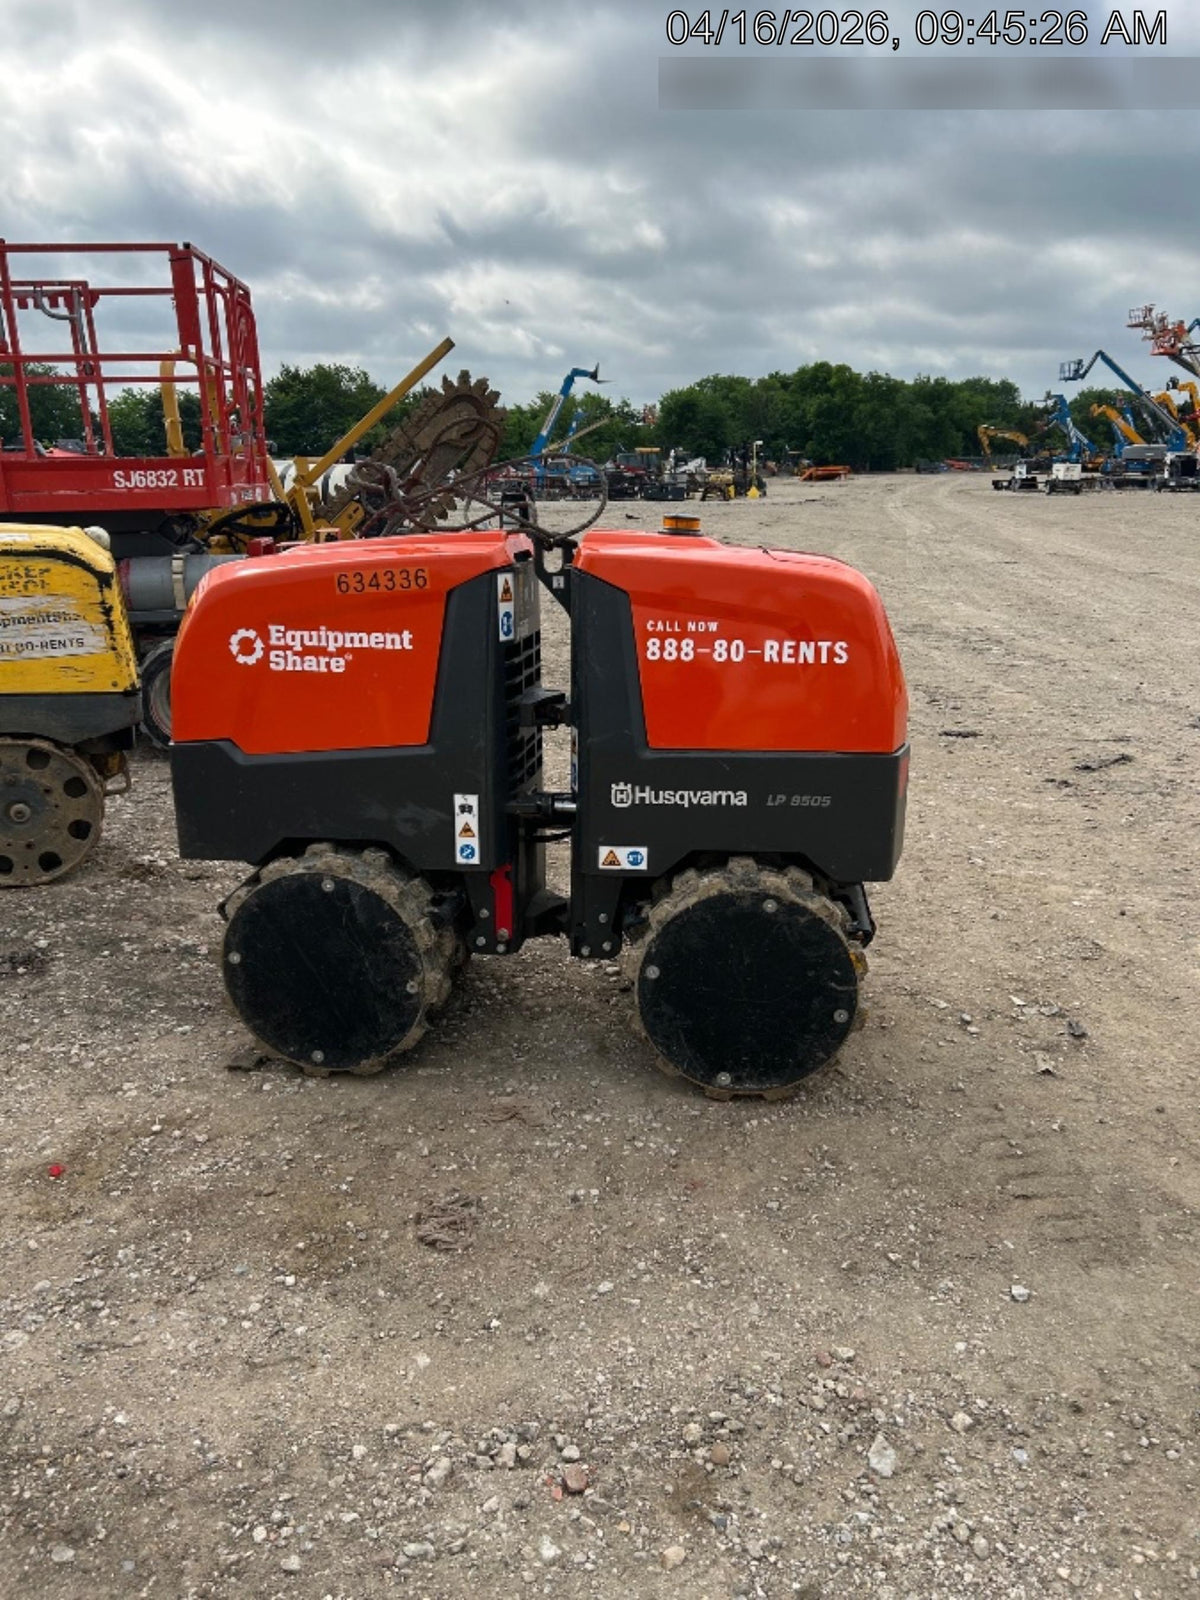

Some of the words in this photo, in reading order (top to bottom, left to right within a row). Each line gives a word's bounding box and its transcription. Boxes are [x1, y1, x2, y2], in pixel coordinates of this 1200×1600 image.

[113, 469, 178, 488] SJ6832
[183, 468, 205, 486] RT
[337, 568, 428, 594] 634336
[268, 624, 413, 651] Equipment
[646, 620, 682, 633] CALL
[688, 620, 719, 633] NOW
[646, 637, 849, 665] 888-80-RENTS
[634, 785, 748, 808] Husqvarna
[766, 794, 787, 807] LP
